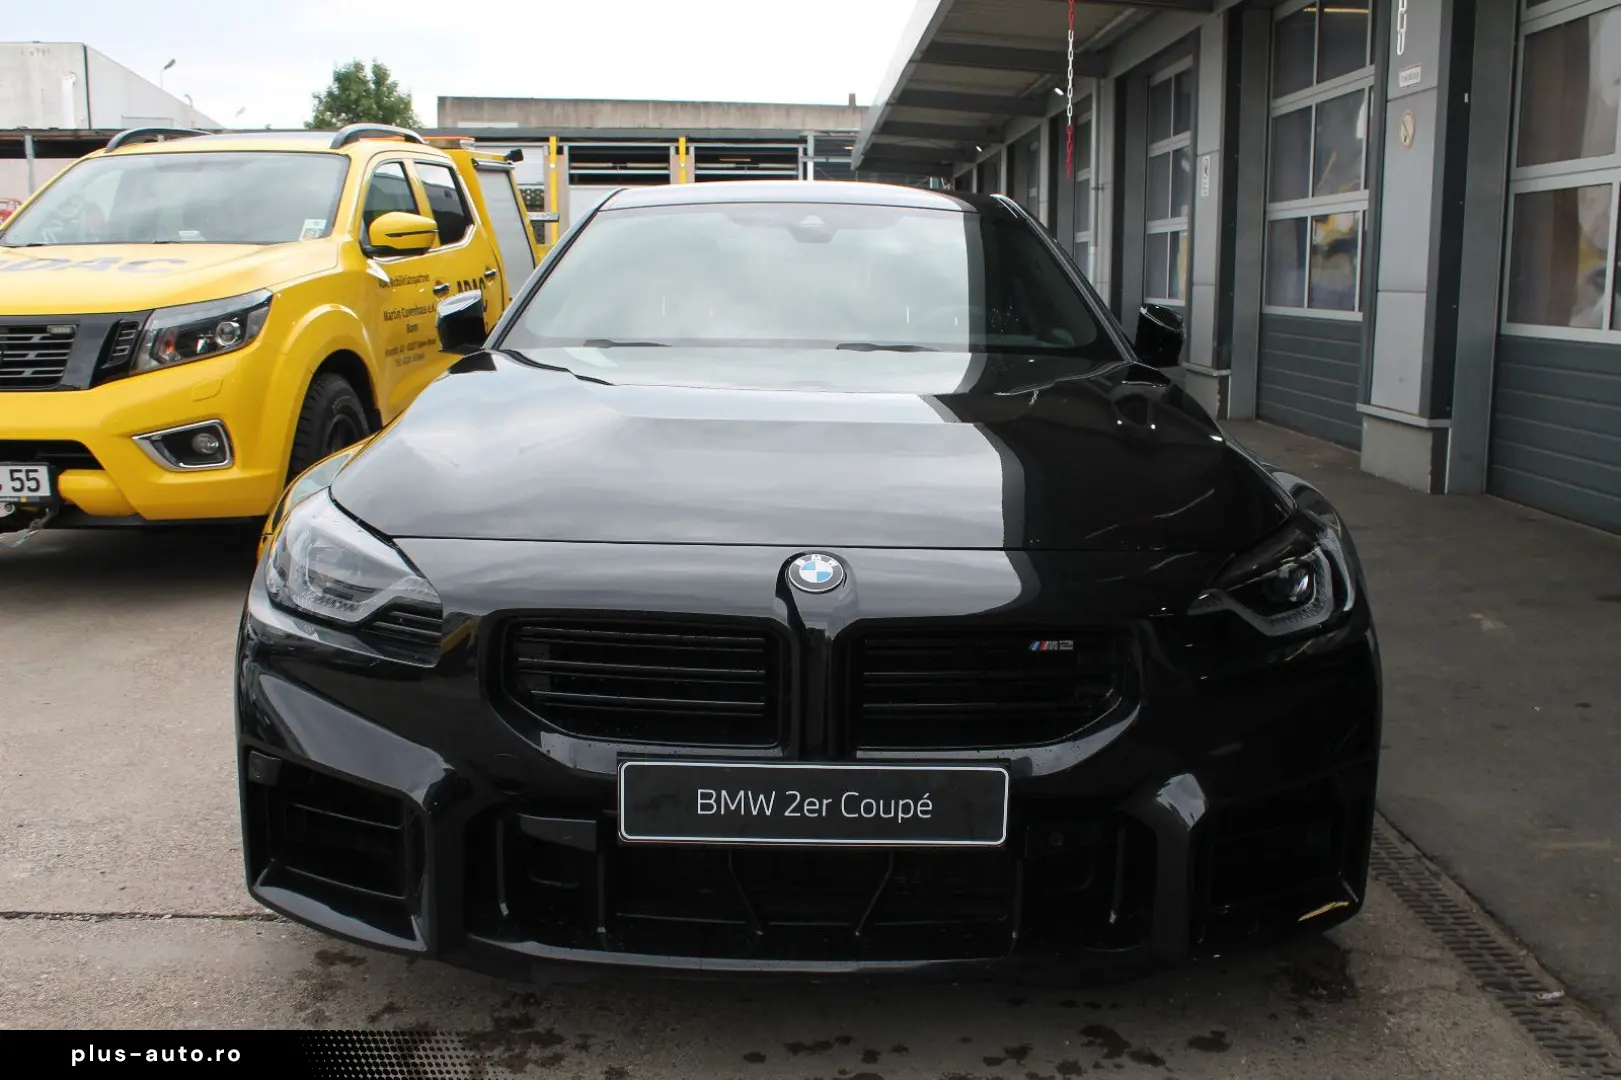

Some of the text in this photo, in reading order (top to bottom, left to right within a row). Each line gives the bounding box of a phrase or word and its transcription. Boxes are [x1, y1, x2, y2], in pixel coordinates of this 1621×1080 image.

[9, 468, 40, 493] 55
[794, 553, 839, 567] BMW
[695, 788, 934, 823] BMW 2er Coupé
